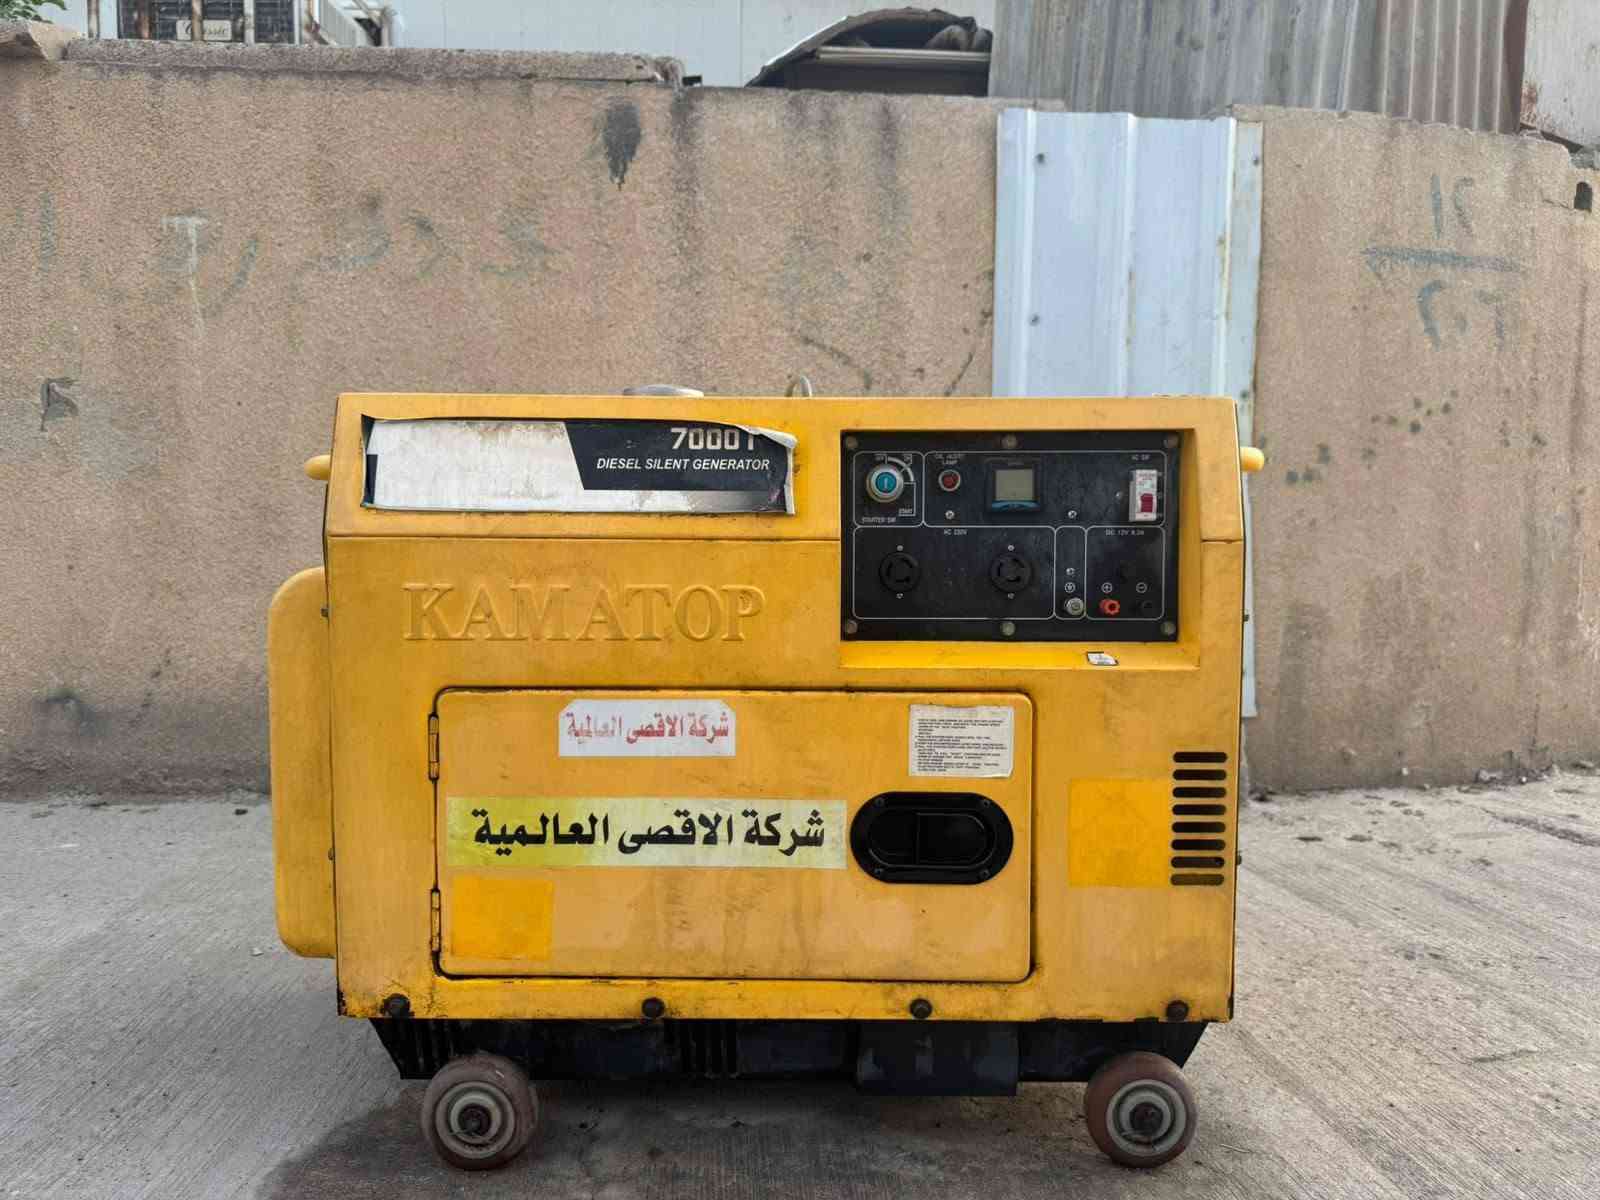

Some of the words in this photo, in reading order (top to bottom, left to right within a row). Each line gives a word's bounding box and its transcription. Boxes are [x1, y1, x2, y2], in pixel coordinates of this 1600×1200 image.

[597, 458, 641, 470] DIESEL
[645, 458, 690, 470] SILENT
[692, 458, 770, 470] GENERATOR
[402, 583, 765, 642] KAMATOP
[688, 711, 729, 744] شركة
[471, 808, 609, 857] العالمية
[618, 808, 733, 854] الاقصى
[741, 808, 825, 856] شركة
